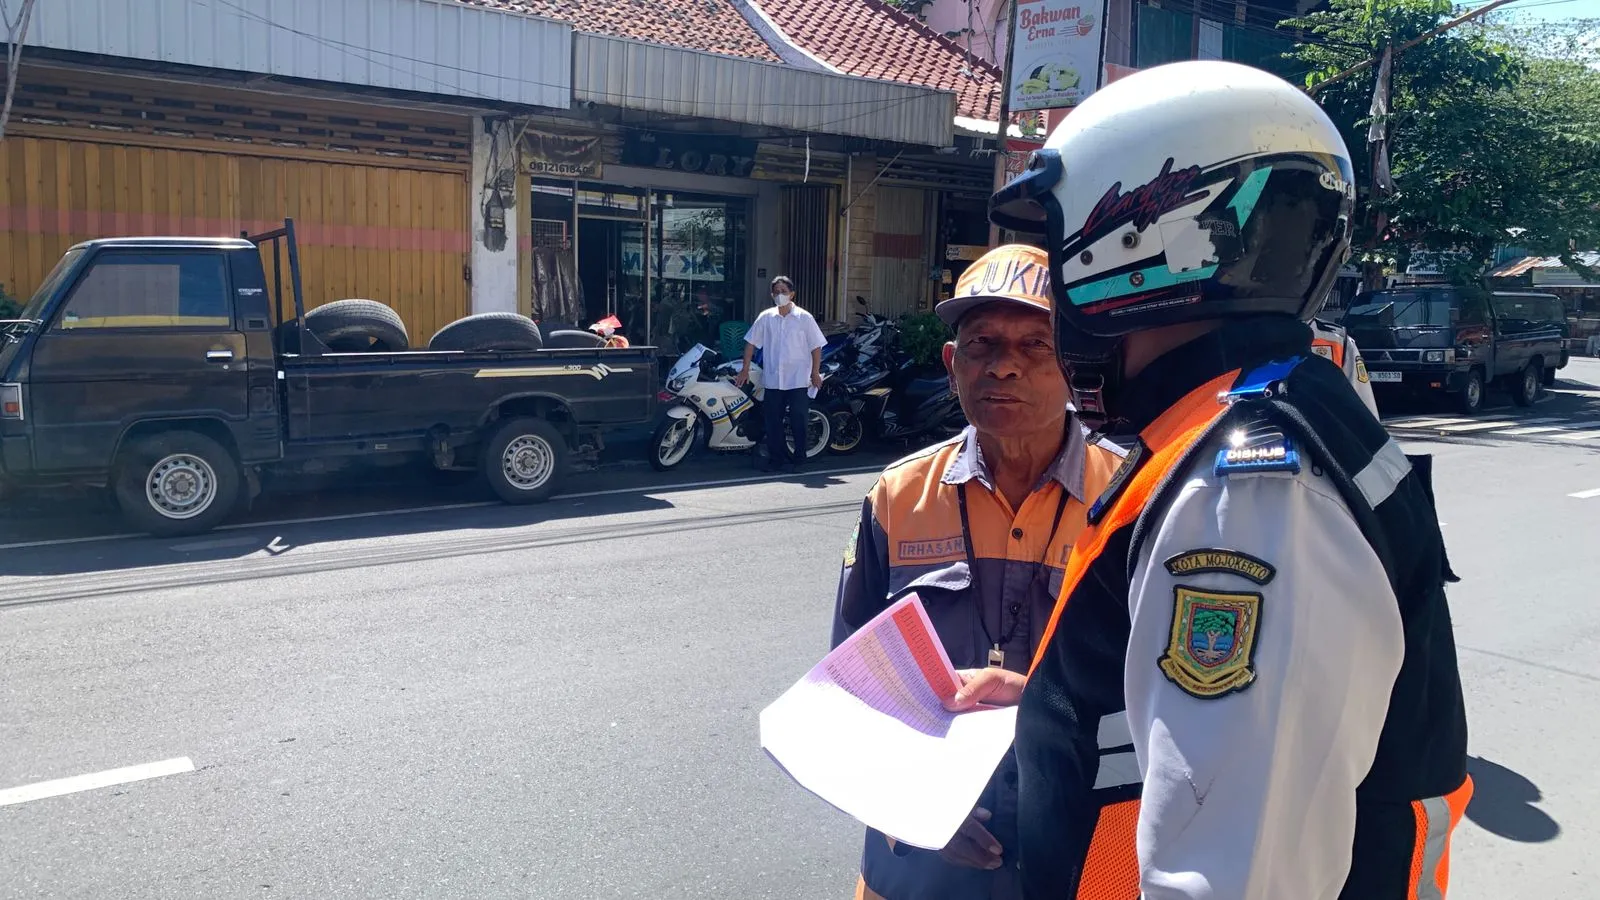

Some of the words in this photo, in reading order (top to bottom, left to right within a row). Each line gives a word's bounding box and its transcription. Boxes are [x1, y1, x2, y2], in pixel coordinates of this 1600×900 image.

[1020, 6, 1081, 29] Bakwan
[1028, 26, 1056, 41] Erna
[1226, 447, 1286, 463] DISHUB
[1173, 556, 1201, 573] KOTA
[1206, 555, 1268, 580] MOJOKERTO
